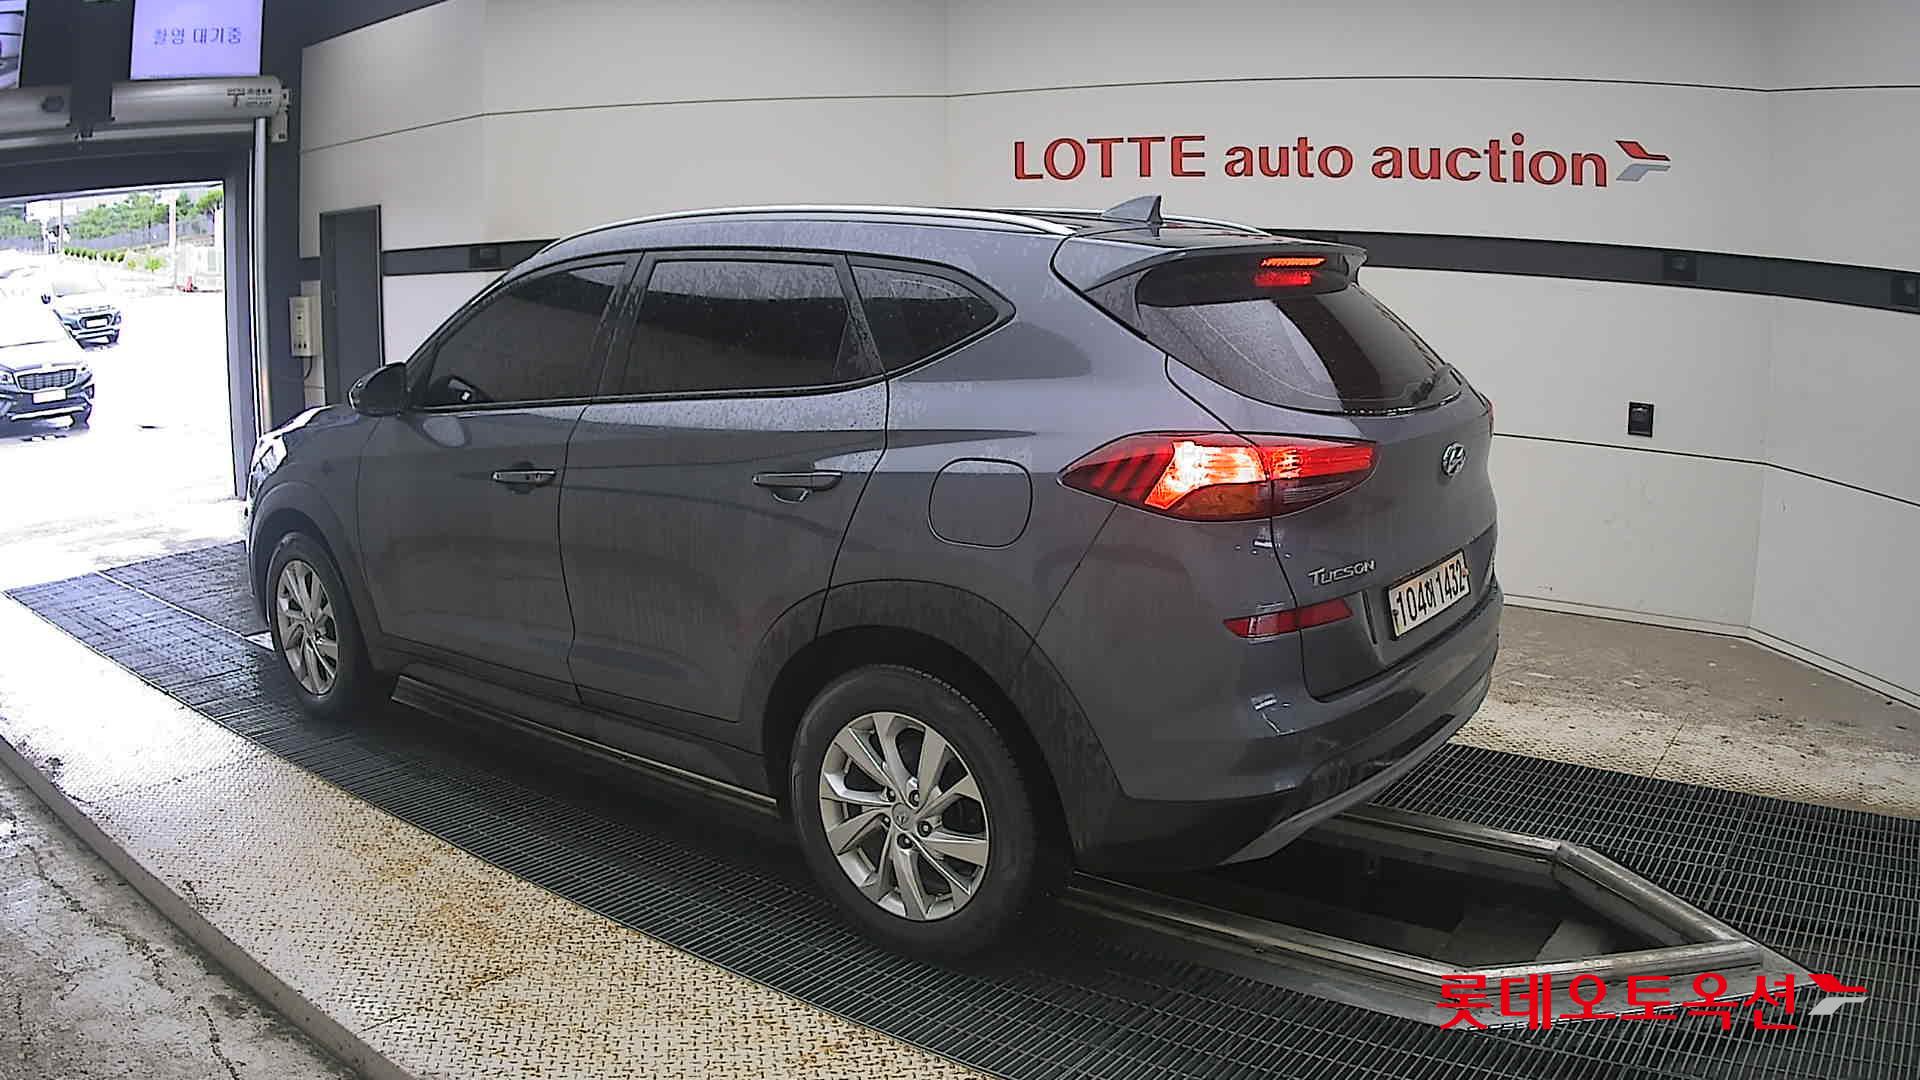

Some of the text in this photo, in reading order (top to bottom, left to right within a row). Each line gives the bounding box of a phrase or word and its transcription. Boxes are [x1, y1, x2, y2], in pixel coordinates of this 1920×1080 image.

[1014, 133, 1608, 187] LOTTE auto auction
[1436, 559, 1465, 604] 1432
